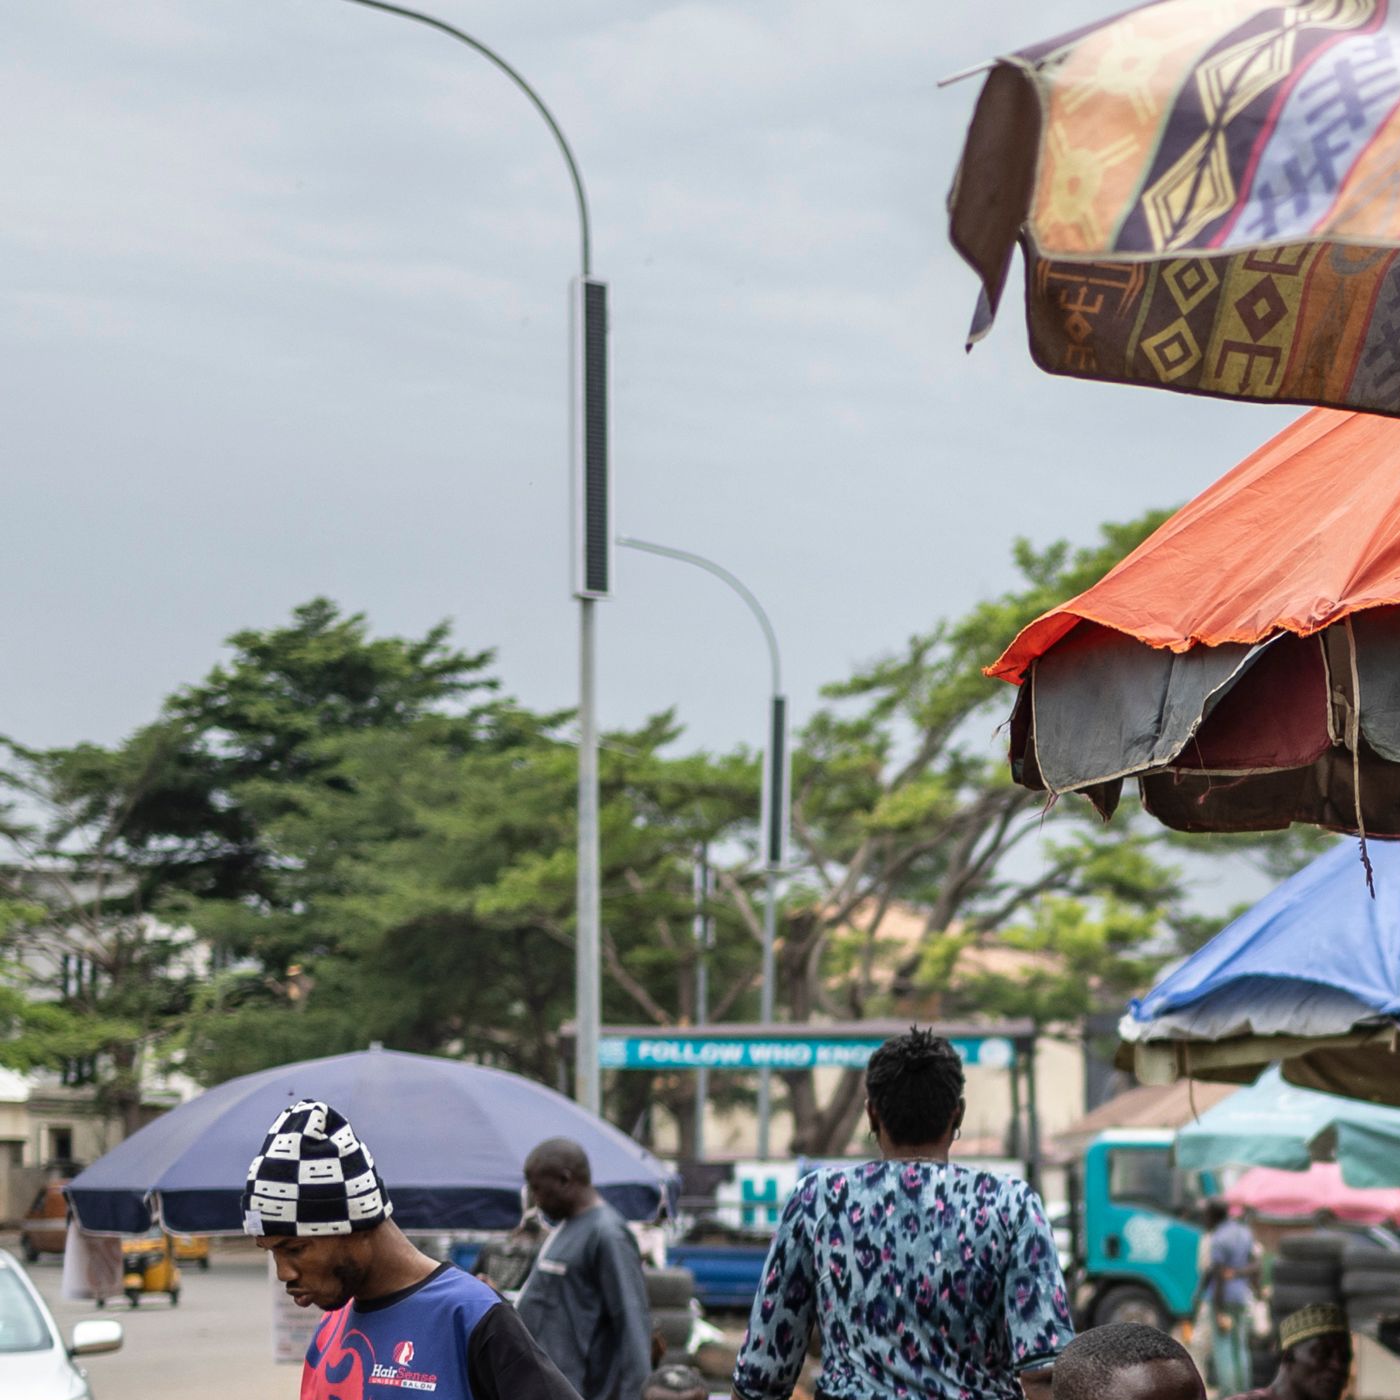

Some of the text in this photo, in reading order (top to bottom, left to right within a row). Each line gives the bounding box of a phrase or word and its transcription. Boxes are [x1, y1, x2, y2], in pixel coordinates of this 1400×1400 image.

[638, 1039, 743, 1063] FOLLOW
[750, 1041, 812, 1064] WHO
[402, 1381, 433, 1389] SALON
